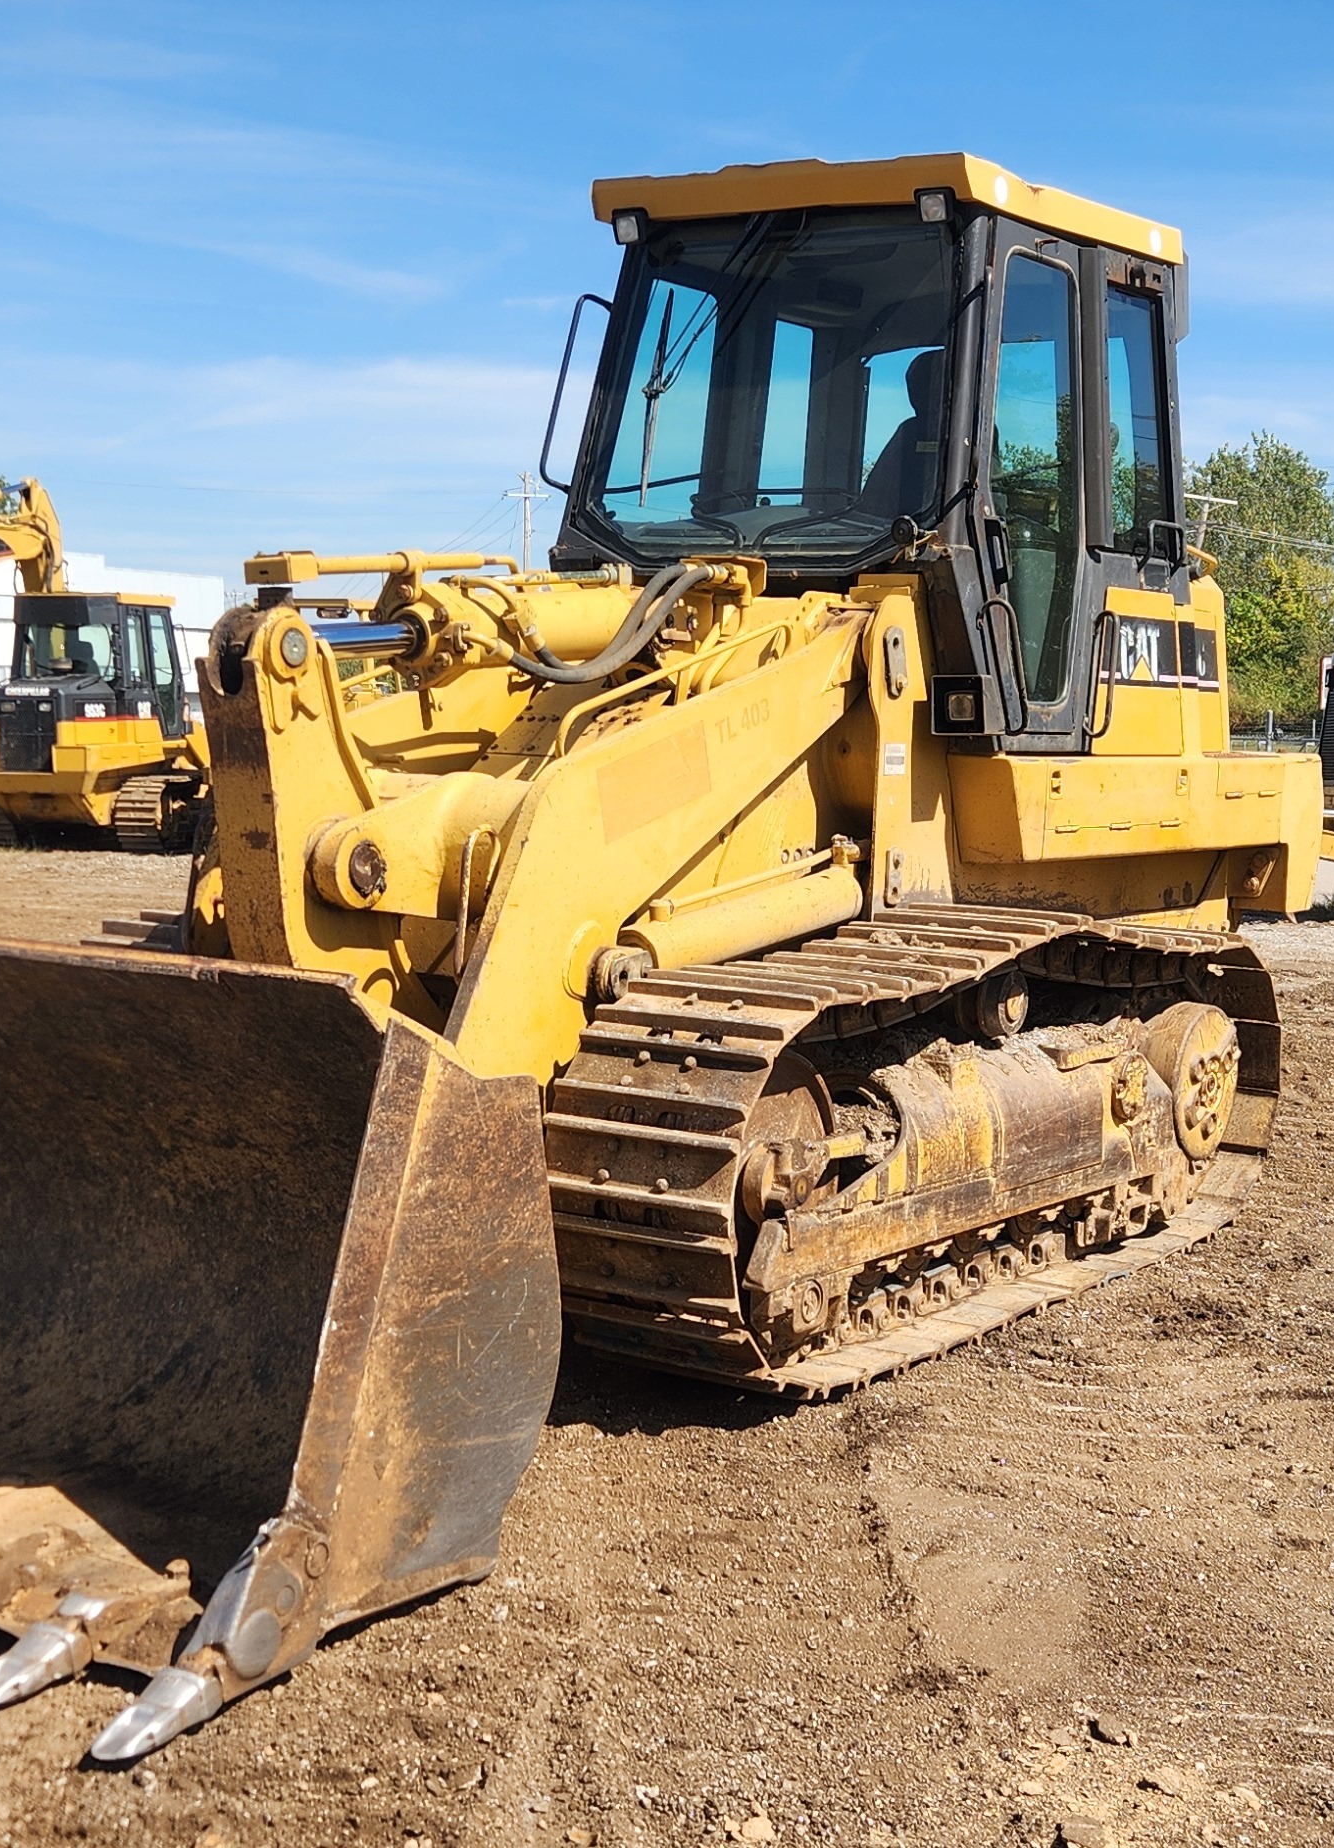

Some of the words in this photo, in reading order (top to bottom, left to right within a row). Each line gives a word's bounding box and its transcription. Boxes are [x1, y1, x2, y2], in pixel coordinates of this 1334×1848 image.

[1120, 622, 1160, 681] CAT
[715, 716, 737, 744] TL
[741, 698, 770, 730] 403
